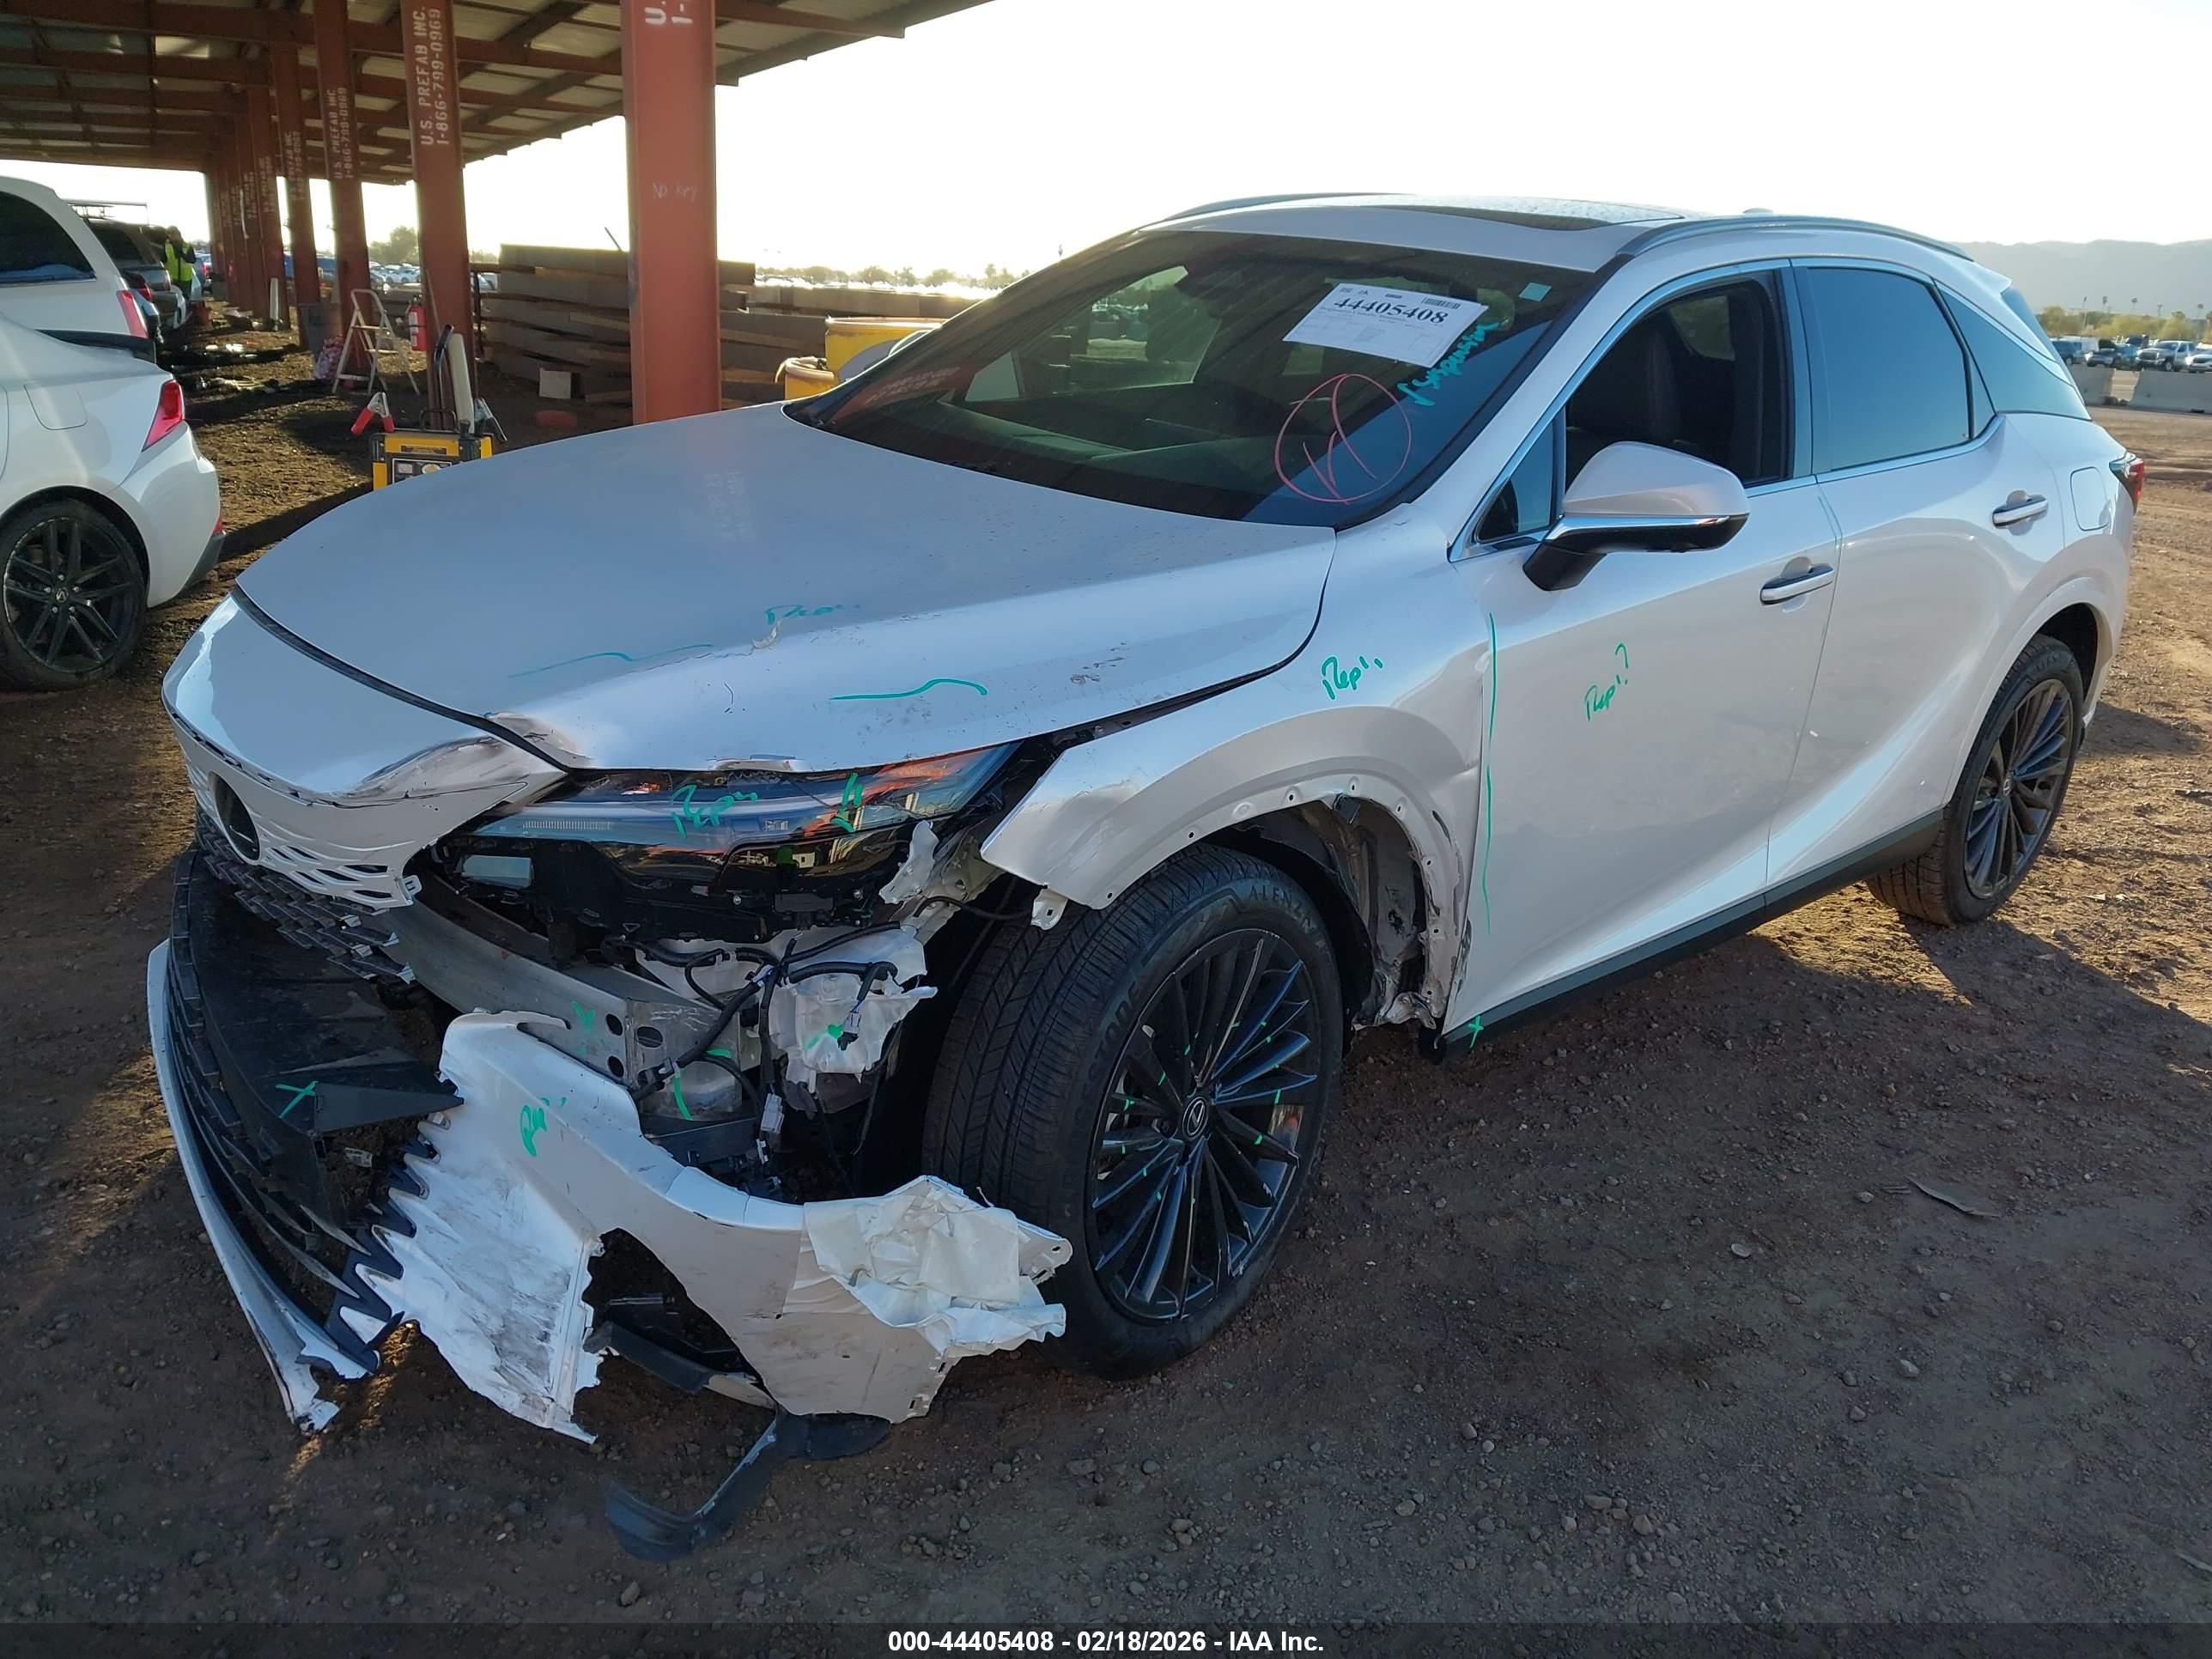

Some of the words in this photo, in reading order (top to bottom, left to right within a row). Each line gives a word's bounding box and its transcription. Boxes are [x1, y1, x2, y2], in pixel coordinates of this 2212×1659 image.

[412, 6, 428, 36] INC.
[415, 45, 432, 106] PREFAB
[429, 9, 449, 144] 1-866-799-0969
[420, 117, 434, 145] U.S.
[1334, 297, 1449, 324] 44405408
